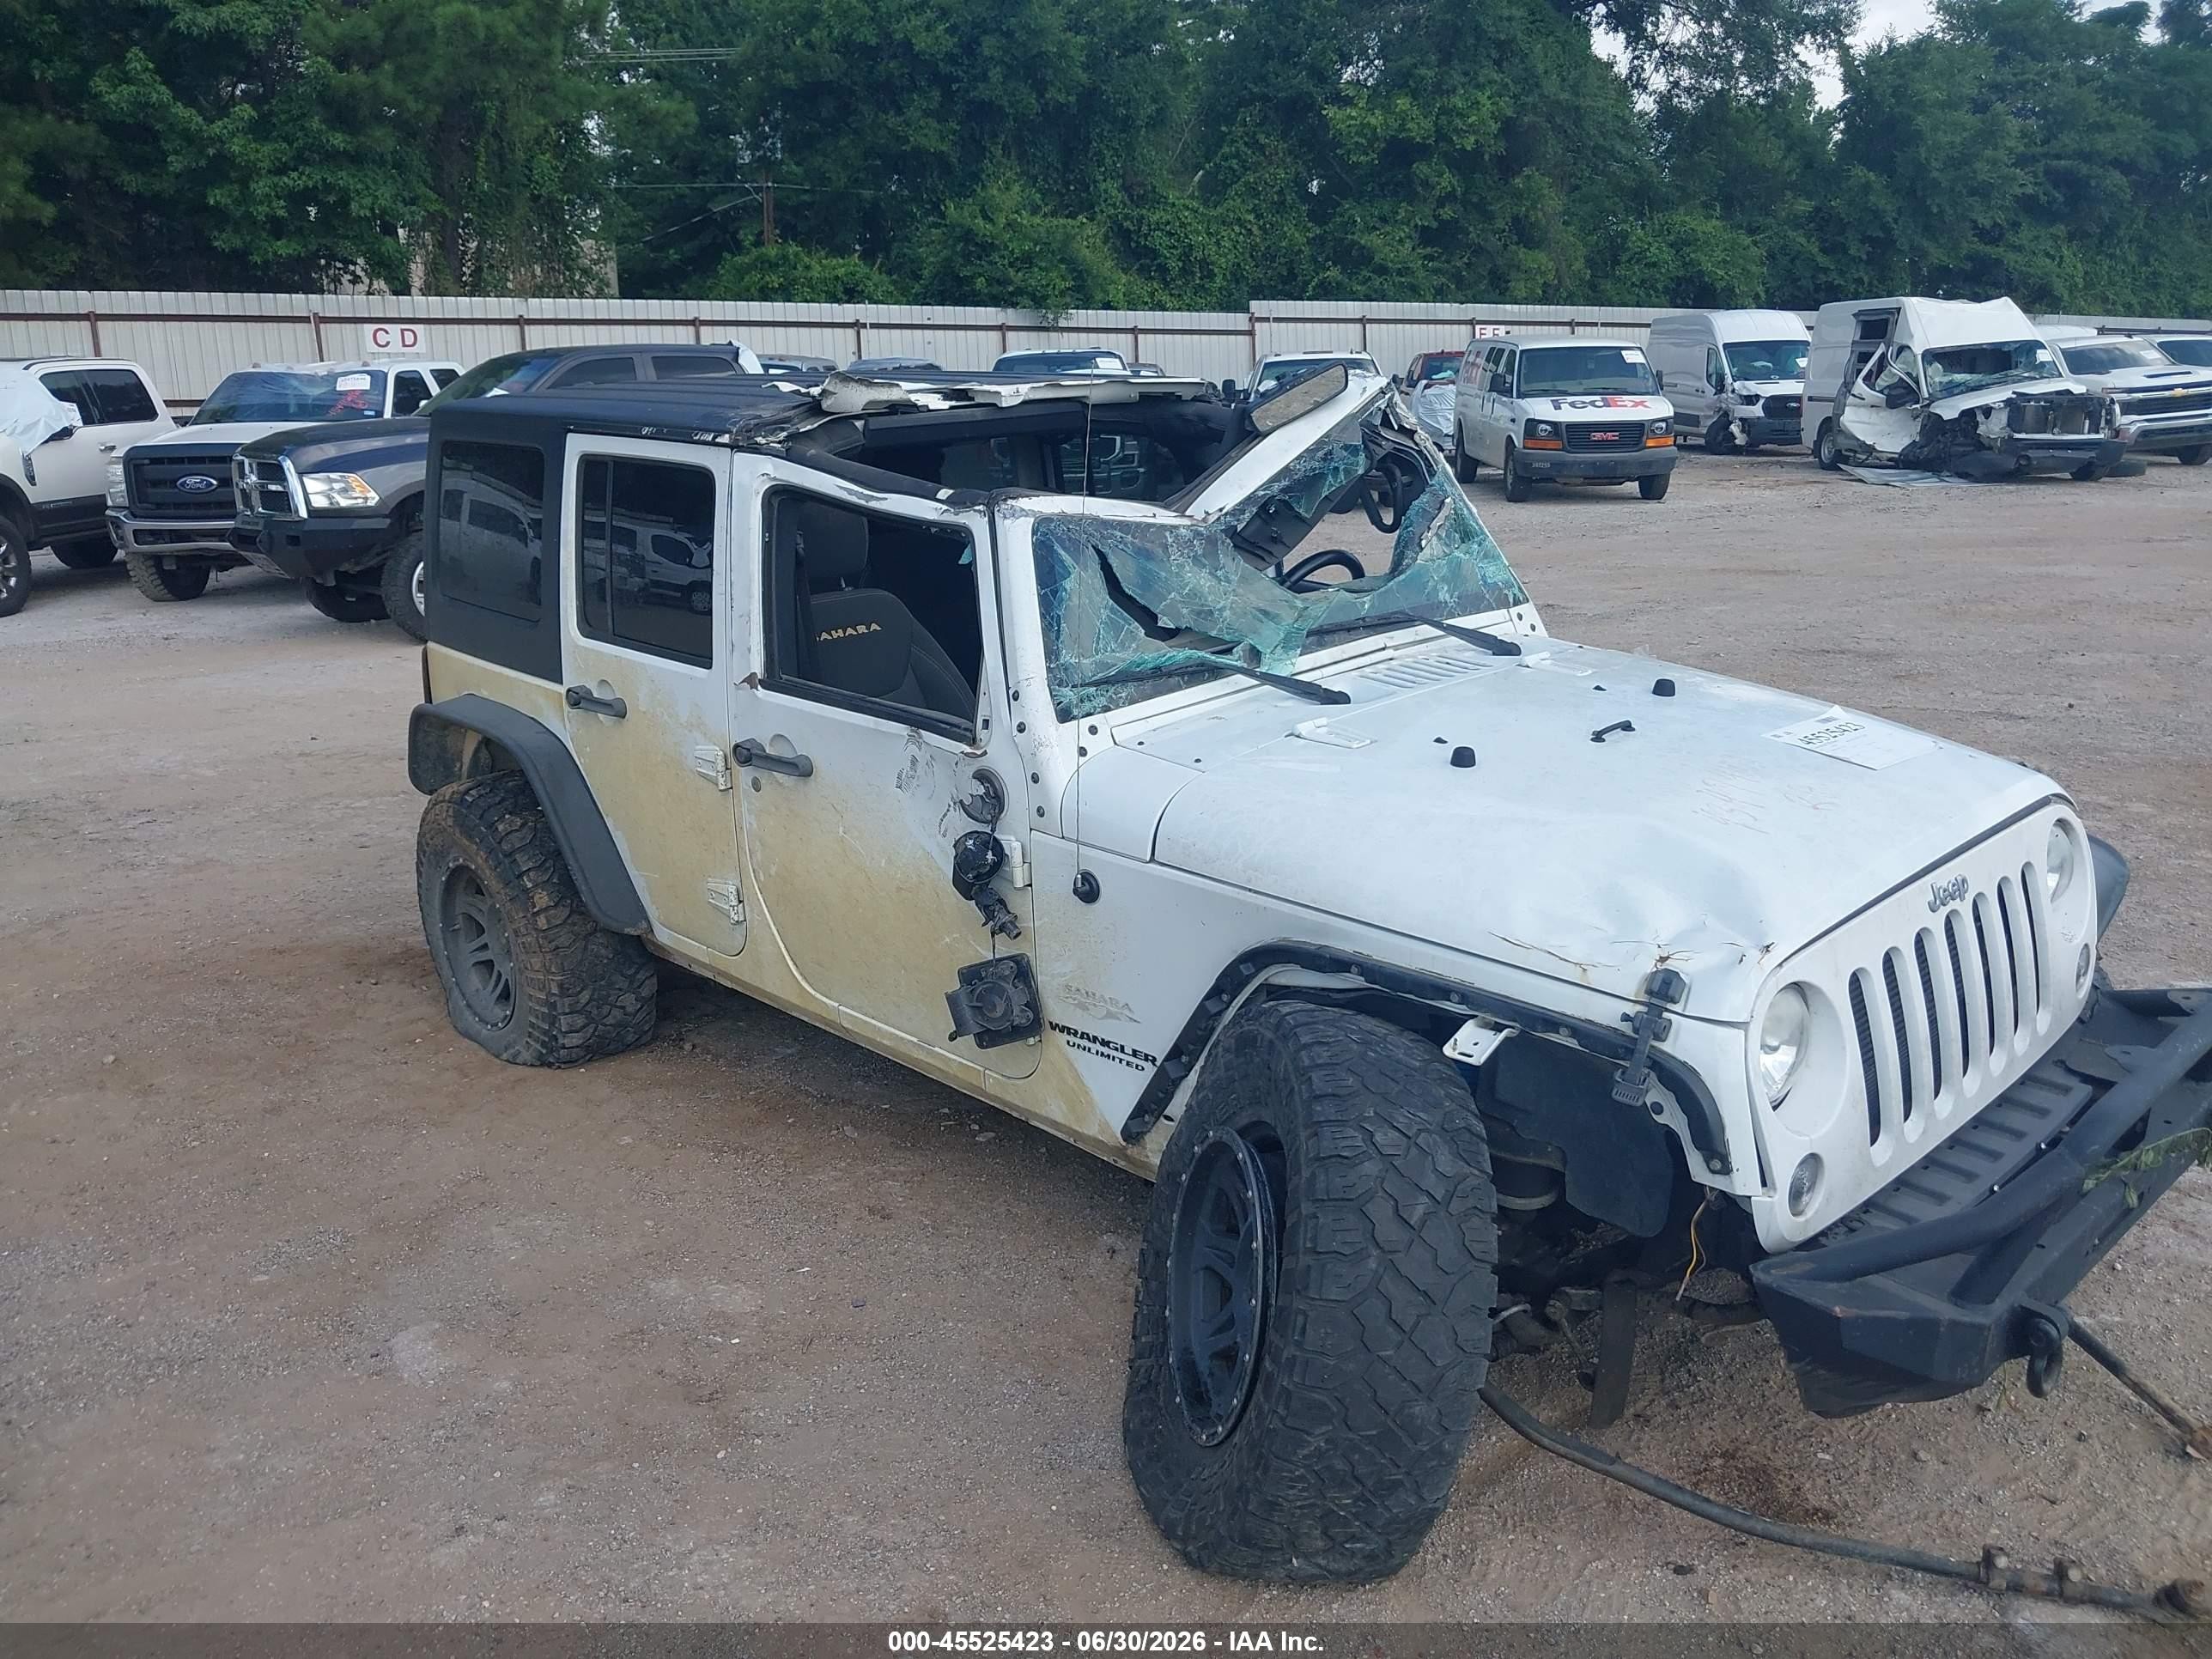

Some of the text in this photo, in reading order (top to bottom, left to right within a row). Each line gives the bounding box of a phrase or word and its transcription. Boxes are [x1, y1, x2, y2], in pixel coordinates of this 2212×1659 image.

[372, 327, 418, 348] C D
[1549, 396, 1651, 410] FedEx
[1589, 432, 1620, 441] GMC
[185, 477, 207, 489] Ford
[1797, 720, 1866, 746] 45525423
[1927, 873, 1969, 914] Jeep
[1048, 1020, 1158, 1068] WRANGLER
[1066, 1039, 1146, 1072] UNLIMITED
